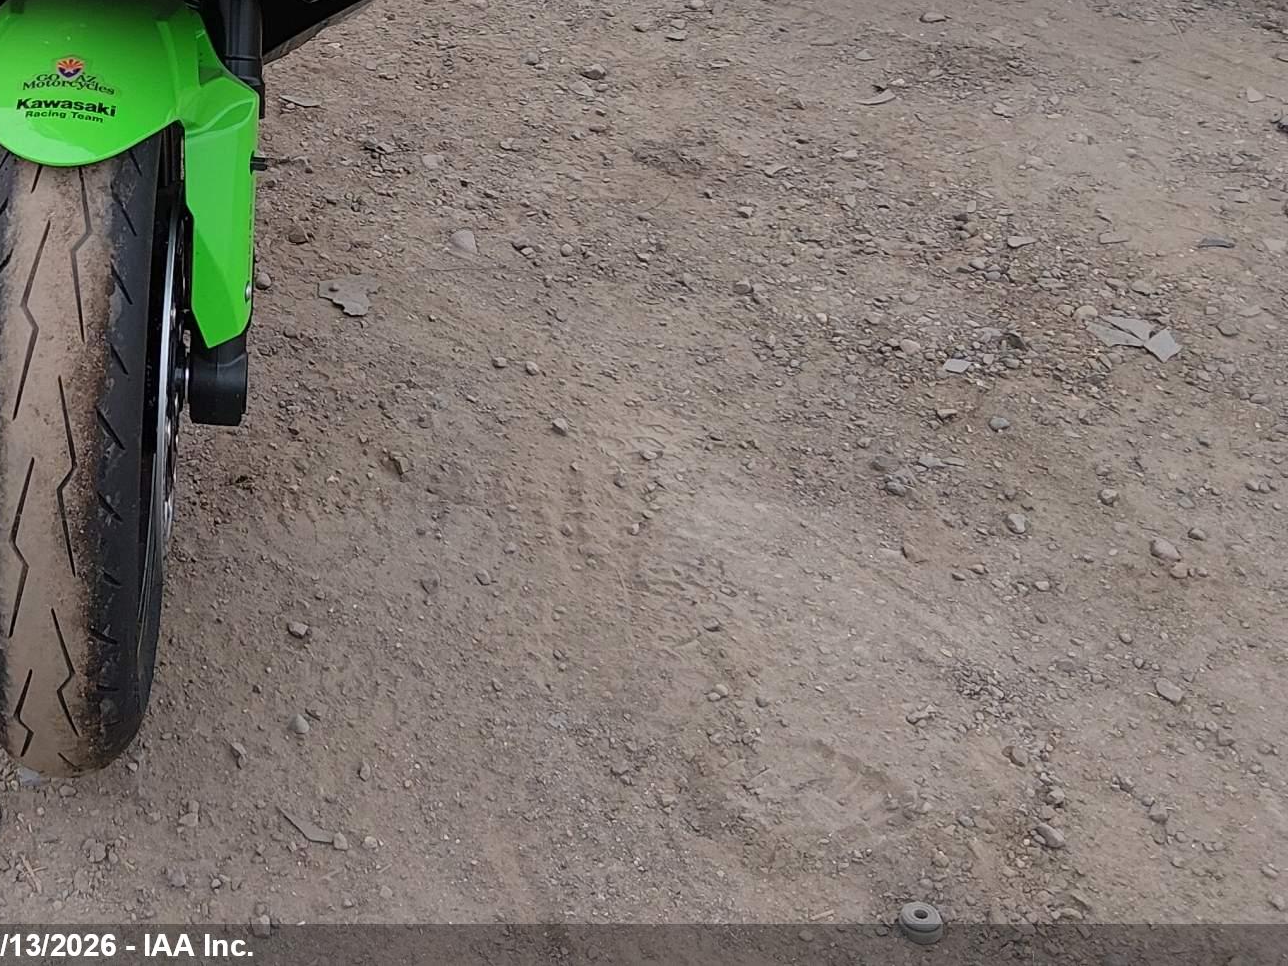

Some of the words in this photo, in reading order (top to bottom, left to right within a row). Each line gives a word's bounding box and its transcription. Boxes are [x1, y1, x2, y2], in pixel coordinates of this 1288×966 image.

[22, 80, 115, 95] Motorcycles
[16, 98, 117, 117] Kawasaki
[25, 109, 67, 119] Racing
[71, 111, 104, 123] Team
